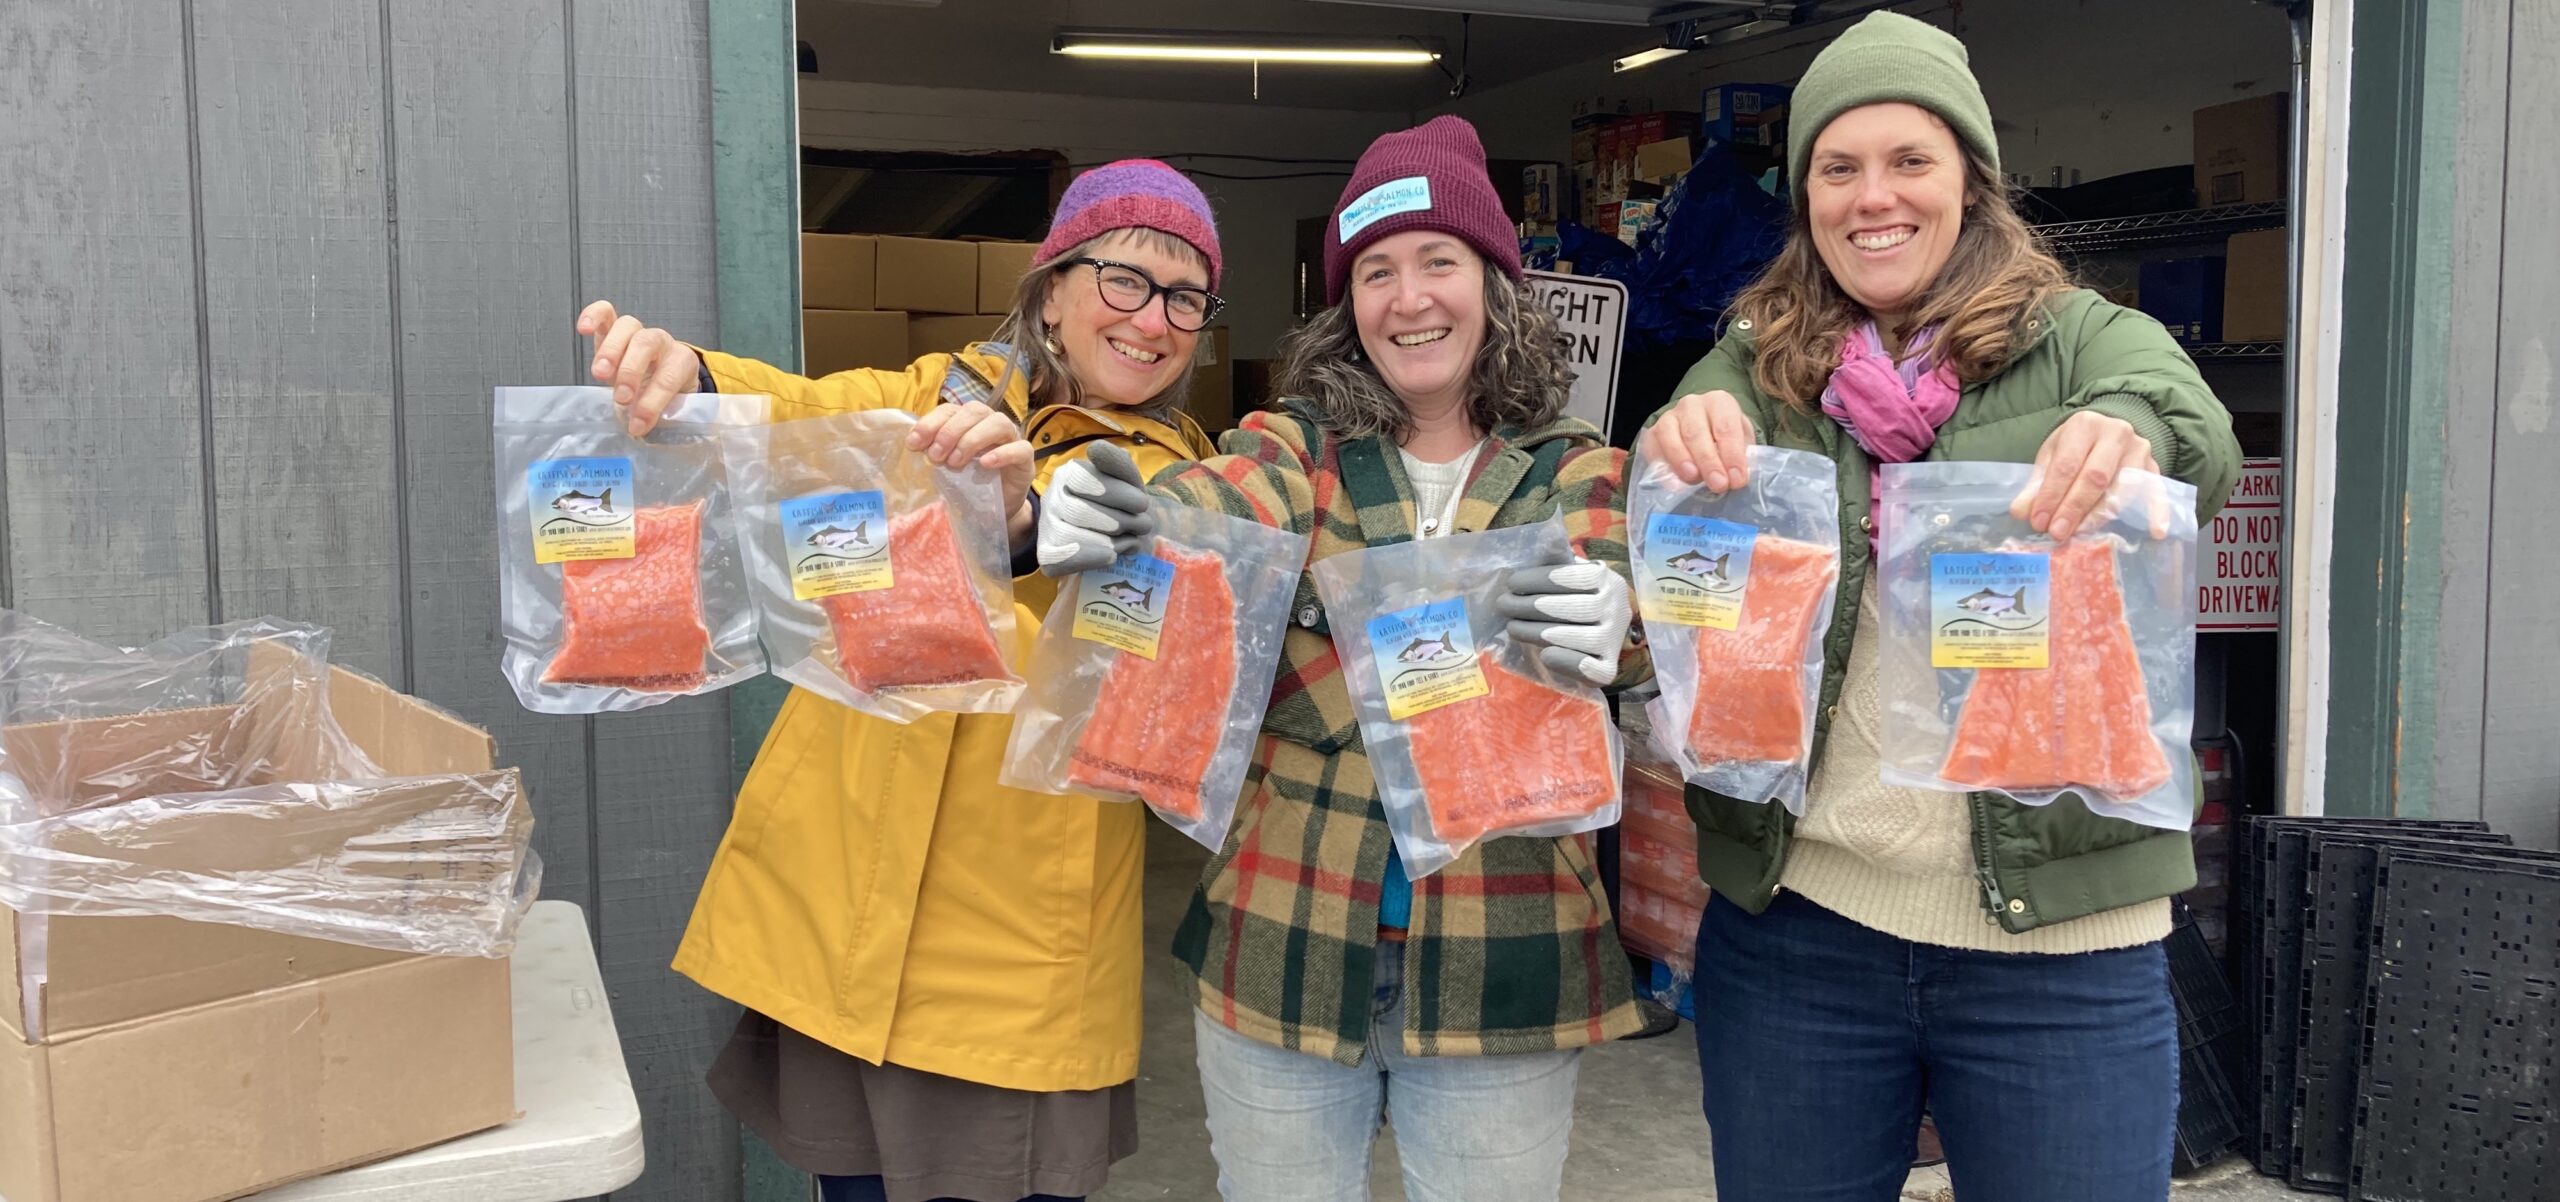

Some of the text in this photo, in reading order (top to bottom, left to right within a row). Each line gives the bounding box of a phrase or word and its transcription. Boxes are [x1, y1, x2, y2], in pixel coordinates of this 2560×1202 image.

[1383, 187, 1412, 202] SALMON
[1415, 186, 1425, 196] CO
[1556, 331, 1600, 365] RN
[580, 468, 611, 479] SALMON
[613, 468, 624, 478] CO
[2232, 475, 2280, 496] ARKI
[834, 501, 865, 514] SALMON
[868, 501, 877, 510] CO
[2214, 516, 2280, 544] DO NOT
[2217, 550, 2278, 578] BLOCK
[2199, 585, 2279, 613] DRIVEWA
[1419, 611, 1446, 626] SALMON
[1448, 609, 1459, 620] CO
